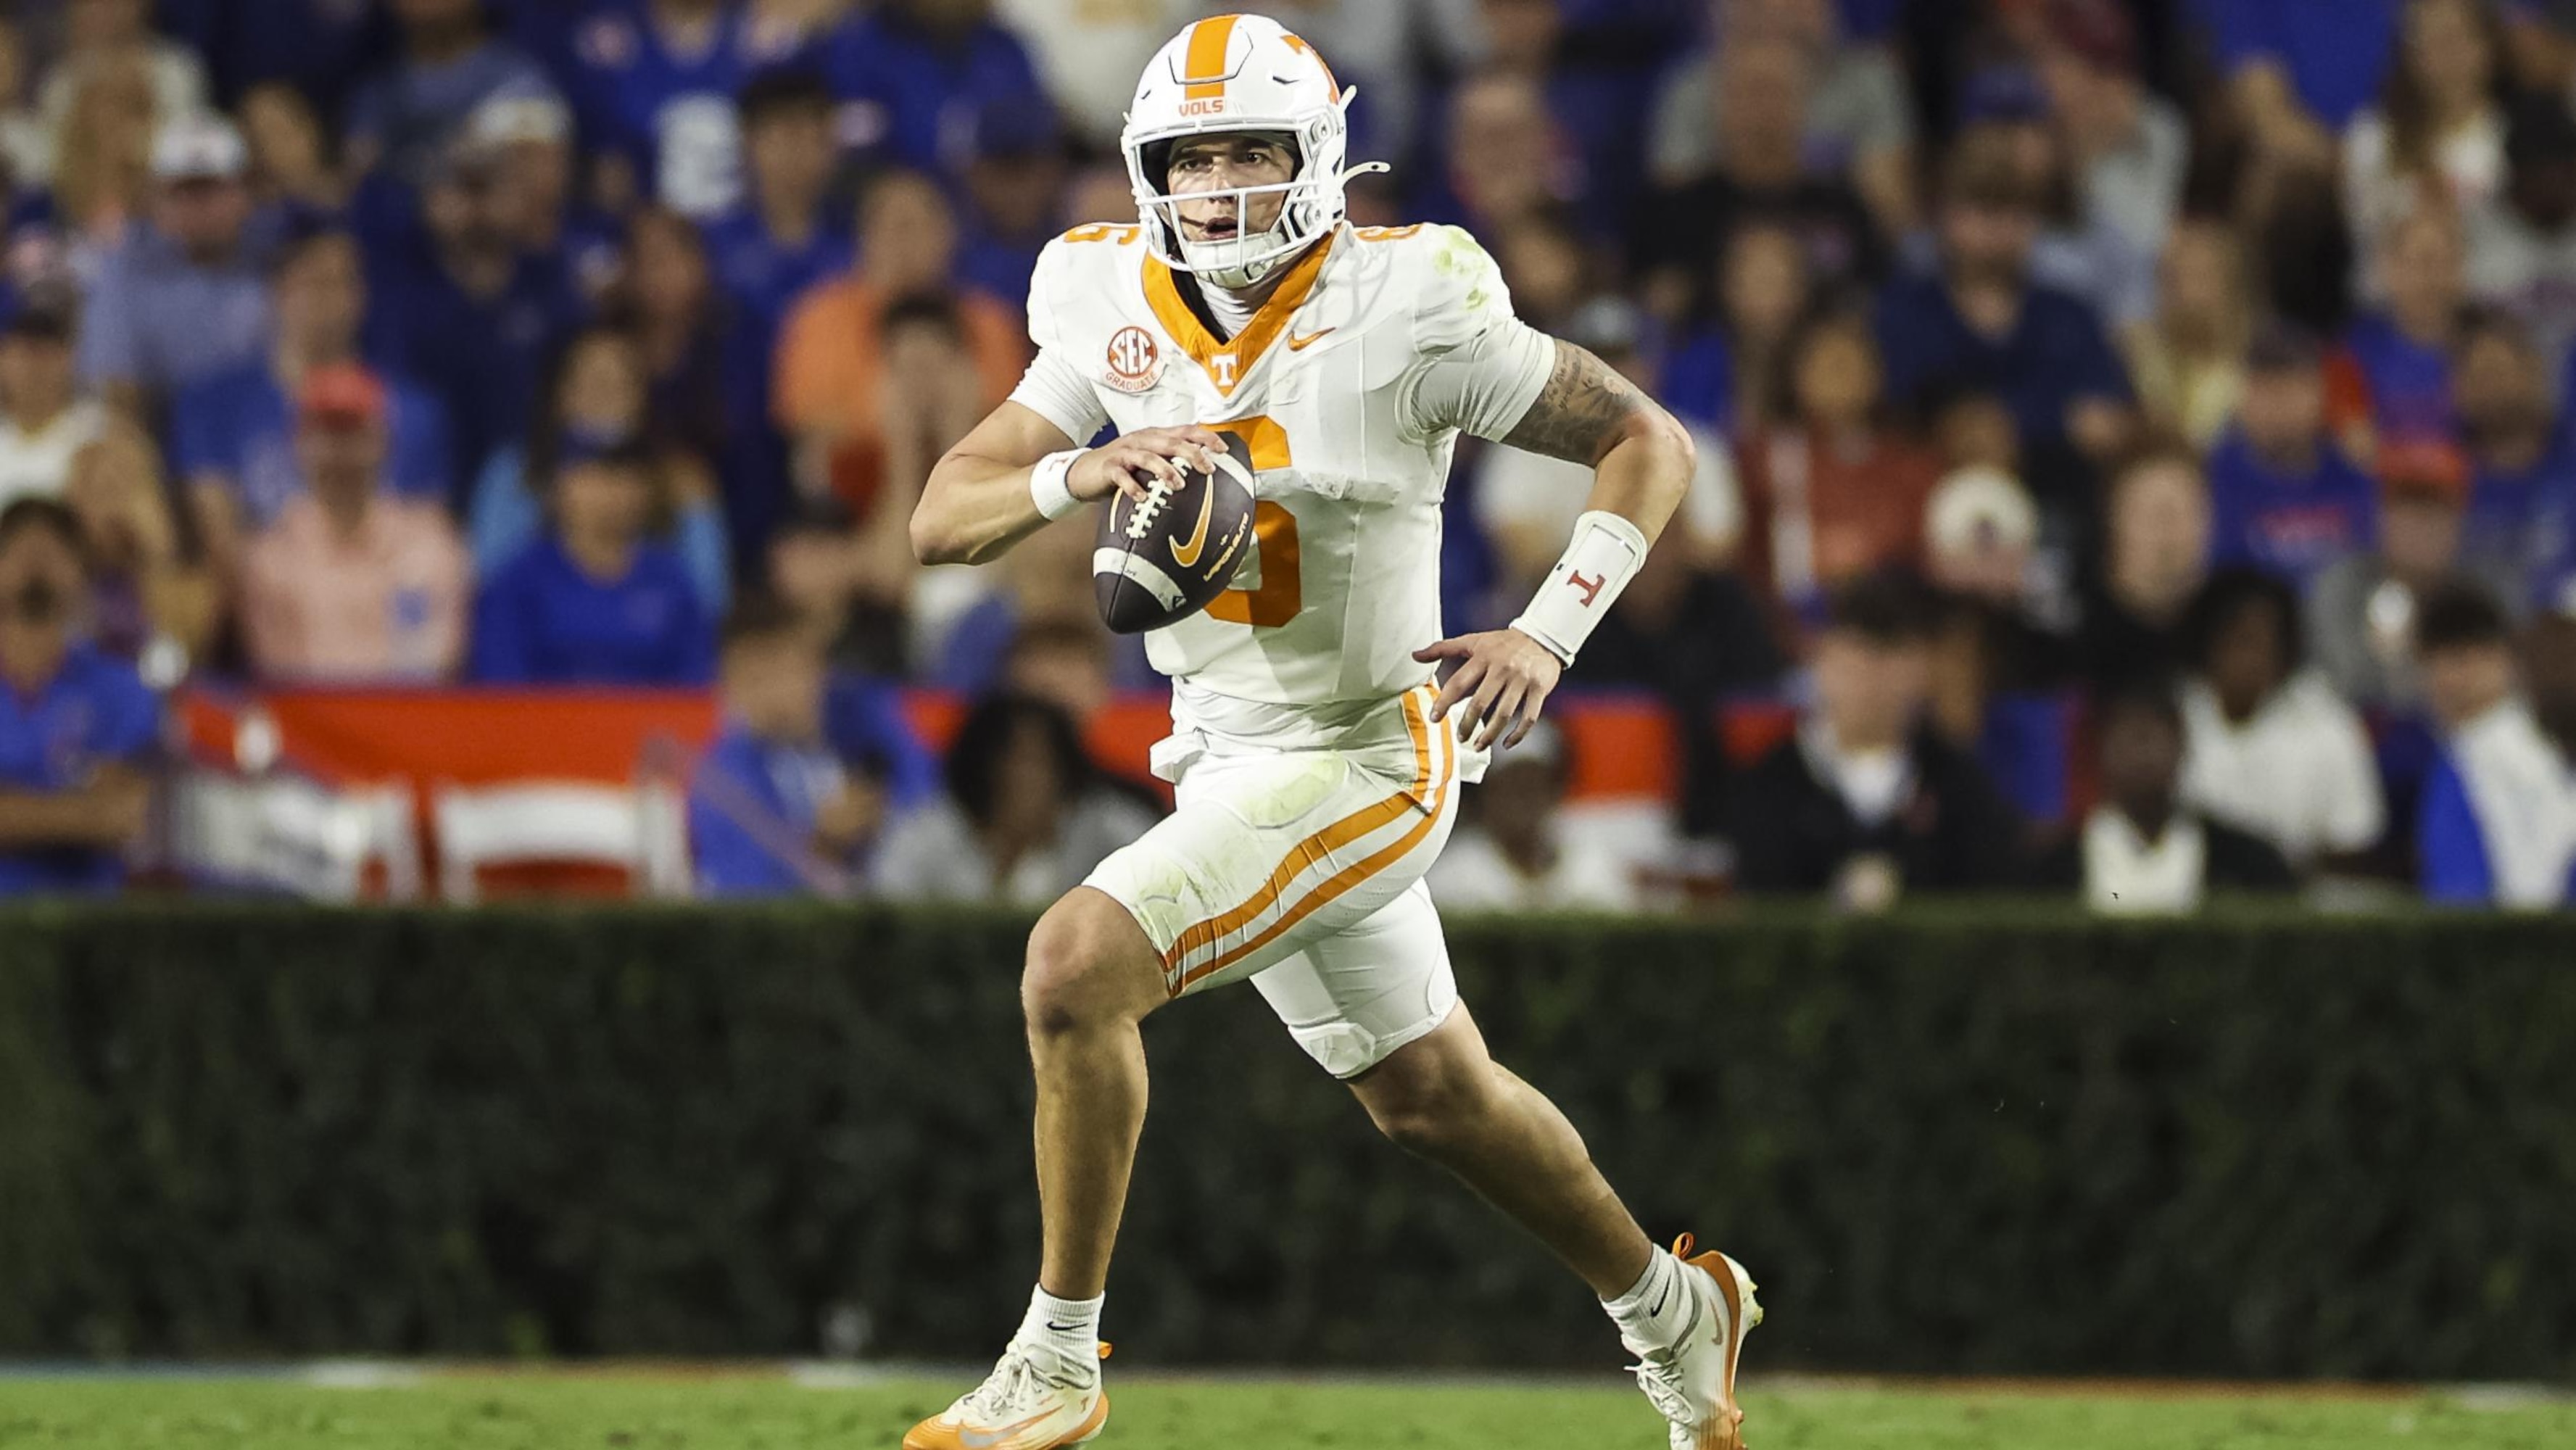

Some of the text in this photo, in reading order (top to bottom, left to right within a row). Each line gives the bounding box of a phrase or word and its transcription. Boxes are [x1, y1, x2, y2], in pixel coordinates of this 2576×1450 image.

[1179, 99, 1224, 117] VOLS
[1111, 329, 1153, 375] SEC
[1106, 370, 1158, 391] GRADUATE
[1211, 355, 1238, 386] T
[1566, 570, 1607, 608] T
